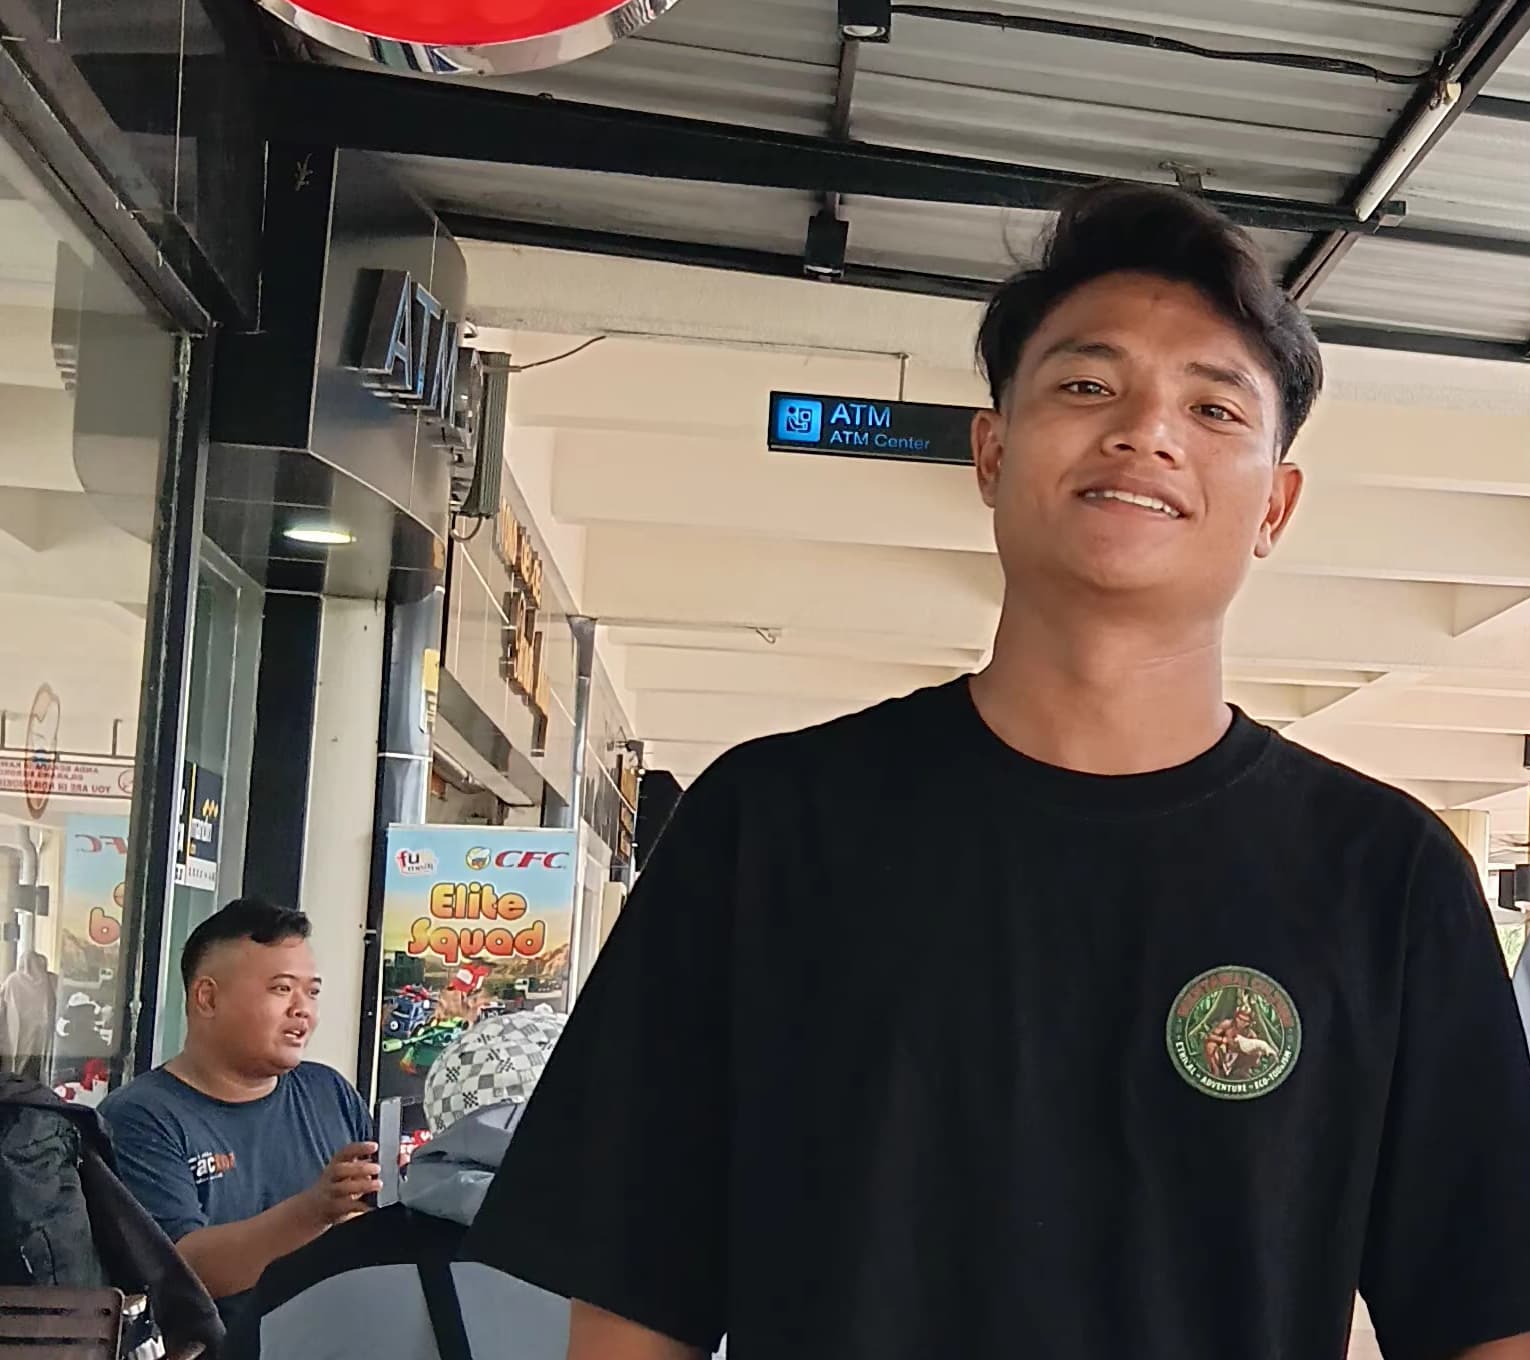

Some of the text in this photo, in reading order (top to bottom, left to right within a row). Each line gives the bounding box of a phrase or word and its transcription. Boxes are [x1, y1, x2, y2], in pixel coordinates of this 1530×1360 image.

[385, 271, 458, 428] ATM
[830, 402, 891, 428] ATM
[830, 430, 930, 450] ATM Center
[494, 850, 570, 869] CFC
[430, 881, 528, 921] Elite
[407, 916, 546, 964] Squad
[1200, 1076, 1248, 1093] ADVENTURE
